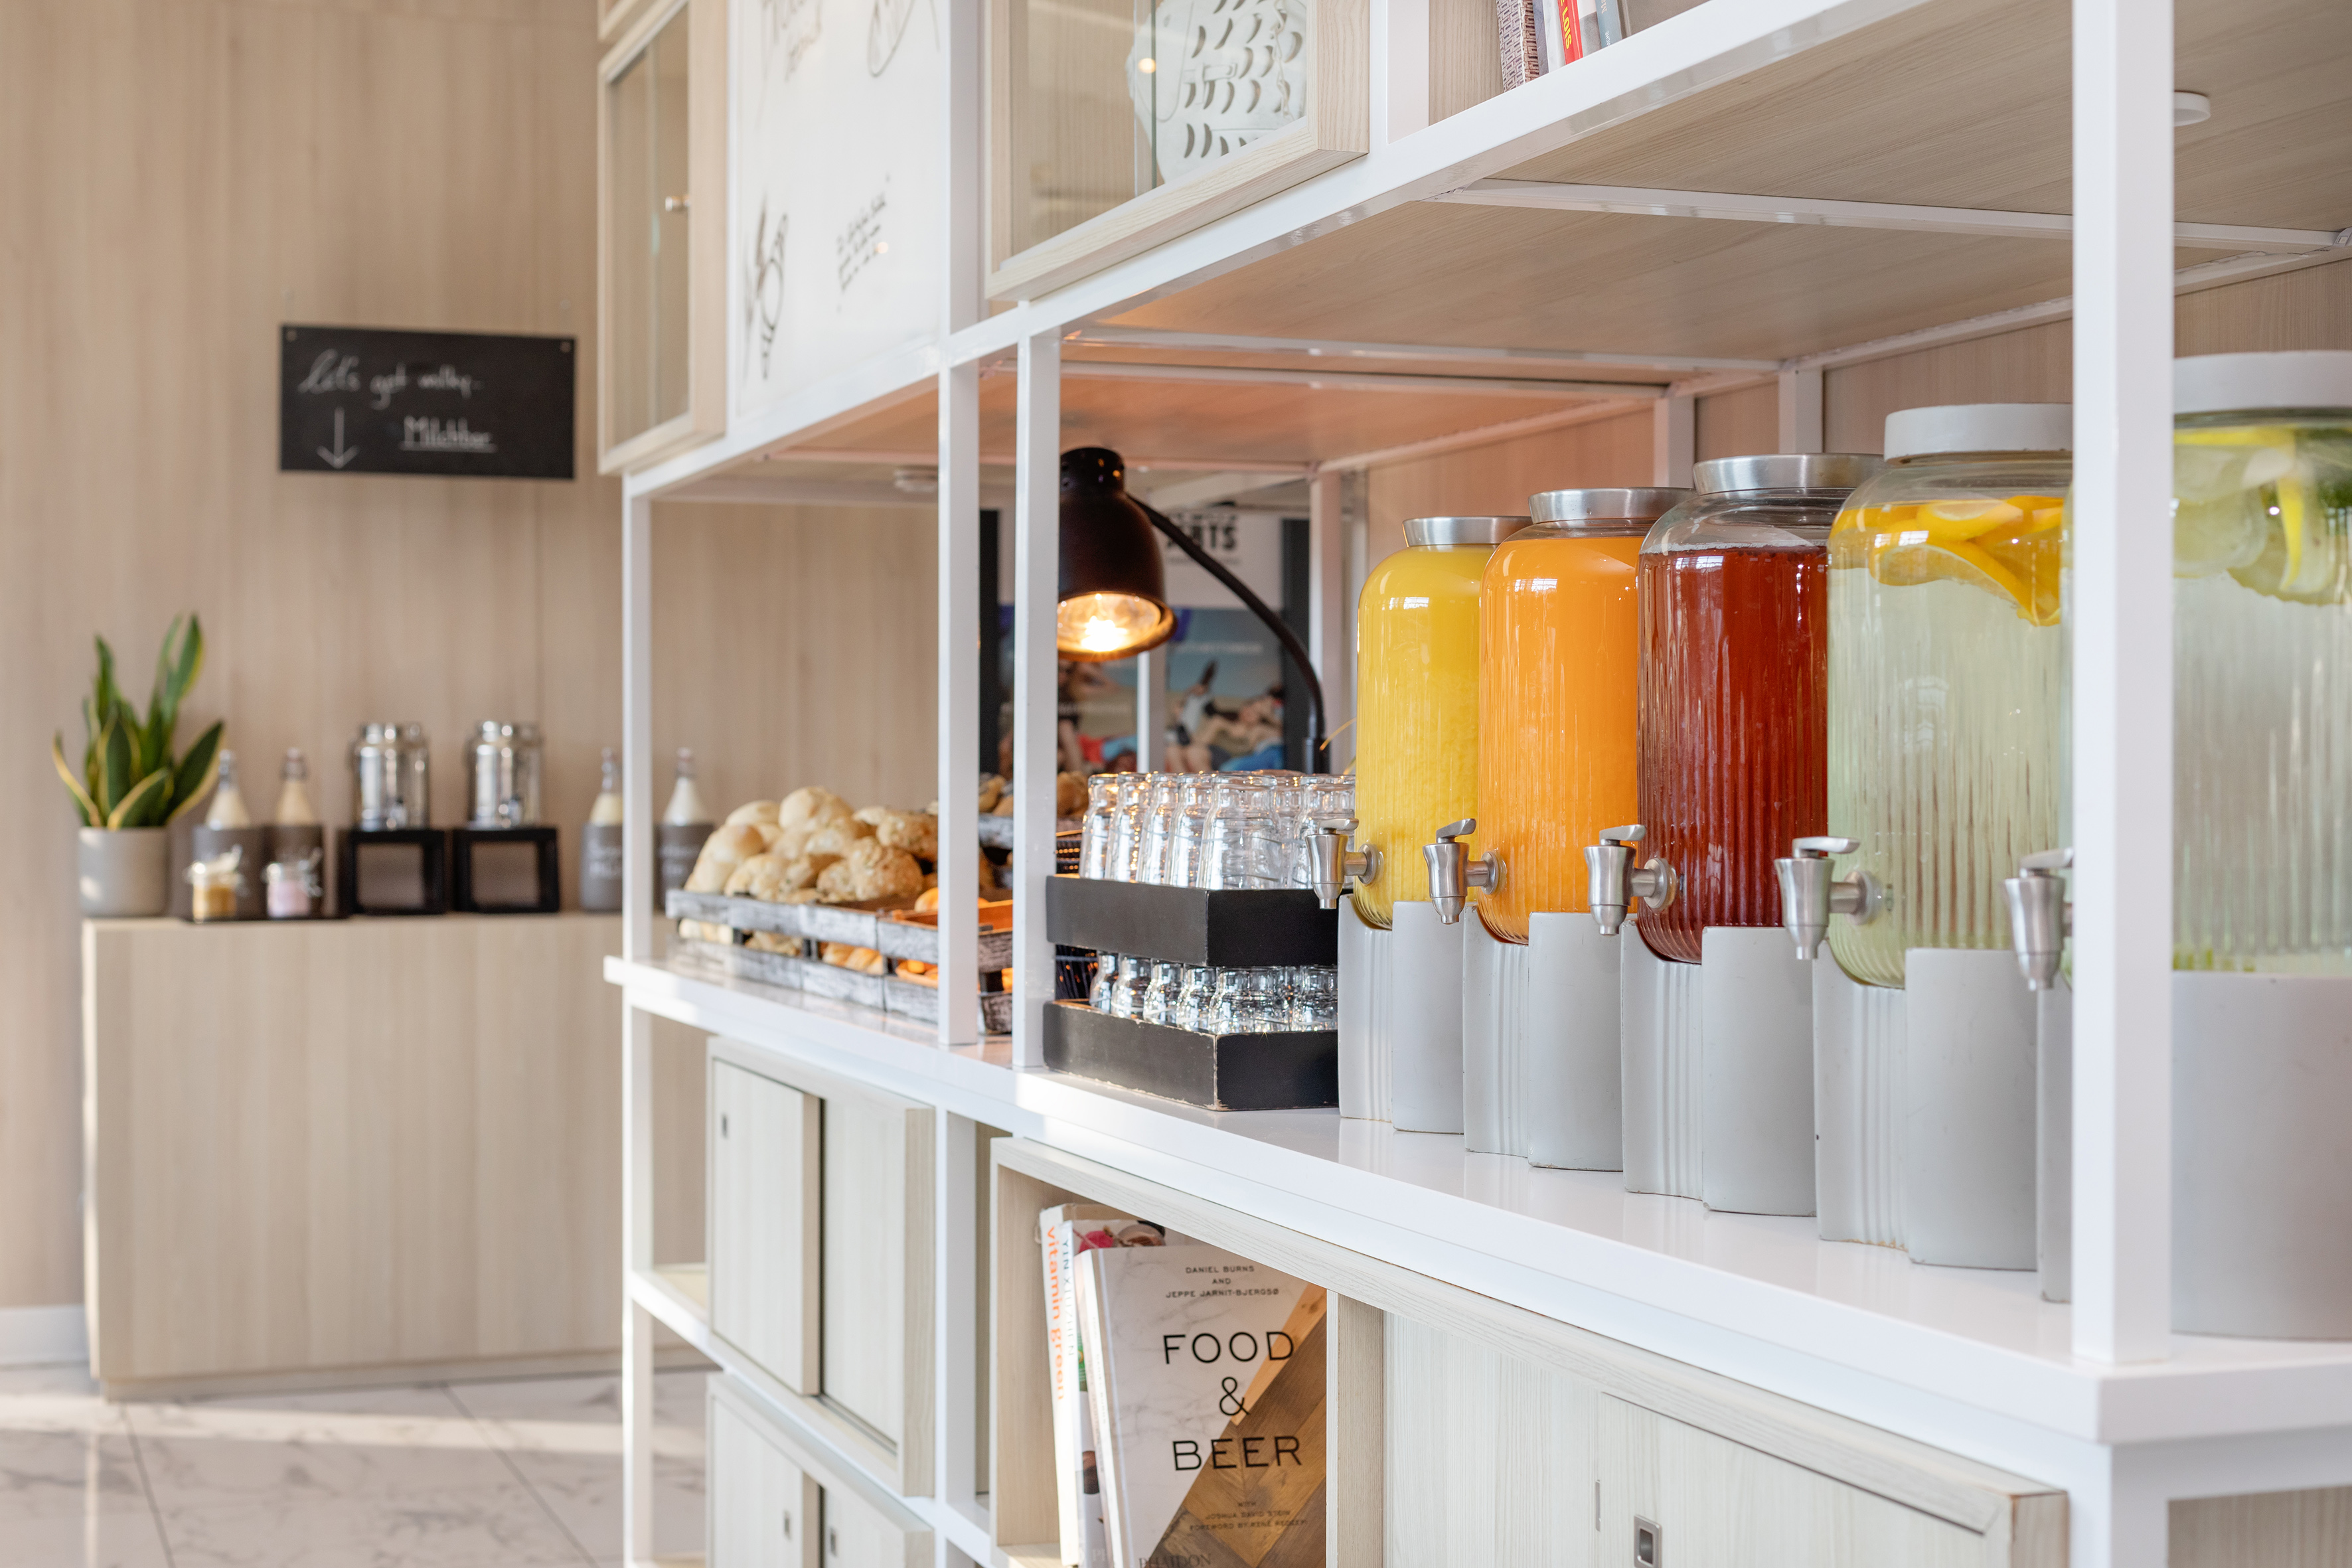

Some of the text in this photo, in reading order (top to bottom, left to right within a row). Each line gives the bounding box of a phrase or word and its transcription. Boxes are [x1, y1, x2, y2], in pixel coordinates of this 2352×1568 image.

[1562, 6, 1572, 50] LOIS
[1223, 1265, 1255, 1273] BURNS
[1166, 1290, 1196, 1298] JEPPE
[1047, 1225, 1063, 1401] vitamin green
[1164, 1332, 1294, 1364] FOOD
[1219, 1376, 1249, 1416] &
[1172, 1435, 1302, 1471] BEER
